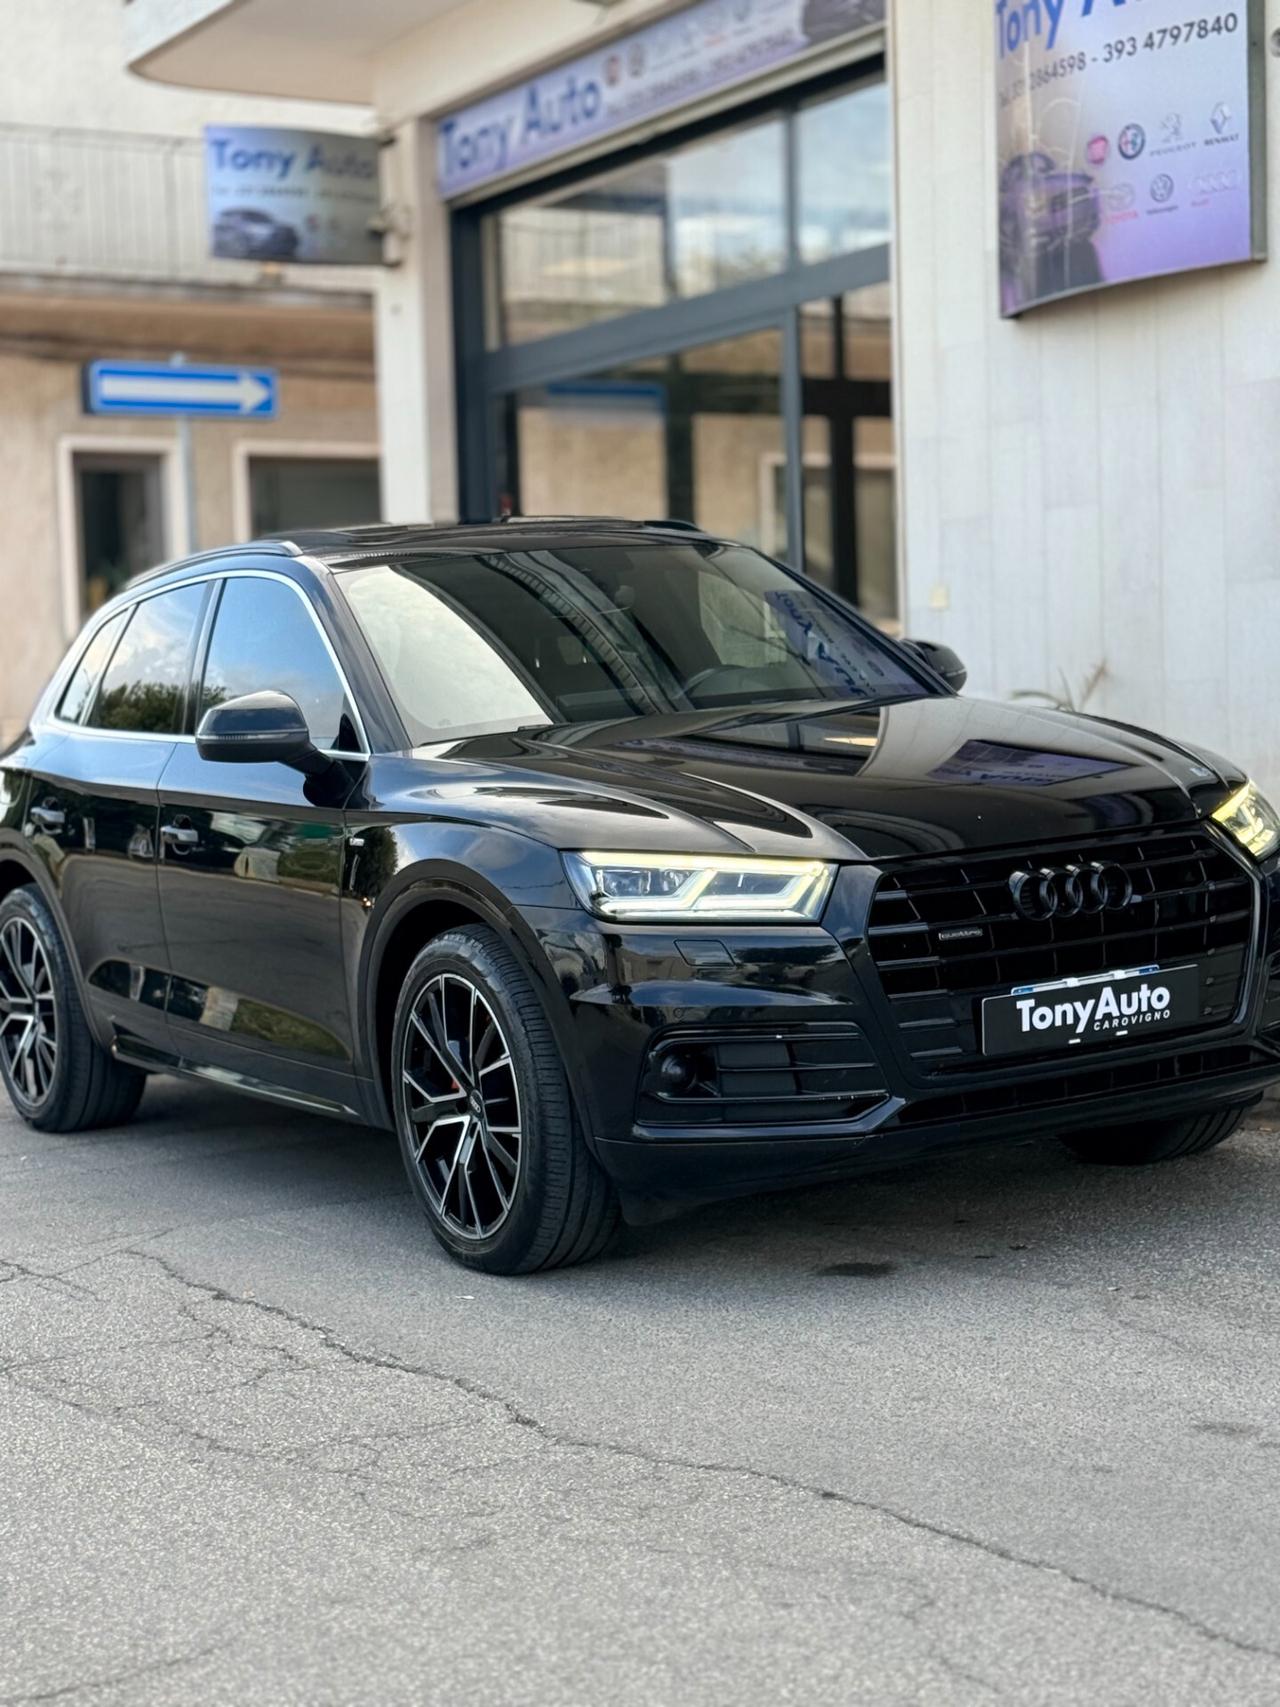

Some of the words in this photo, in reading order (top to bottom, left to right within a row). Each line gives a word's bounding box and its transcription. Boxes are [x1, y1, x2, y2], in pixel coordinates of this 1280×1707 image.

[996, 0, 1064, 57] Tony
[1103, 36, 1138, 64] 393
[1143, 12, 1239, 51] 4797840
[440, 111, 517, 176] Tony
[521, 75, 599, 145] Auto
[210, 138, 294, 181] Tony
[1016, 984, 1171, 1034] TonyAuto
[1094, 1009, 1171, 1032] CAROVIGNO
